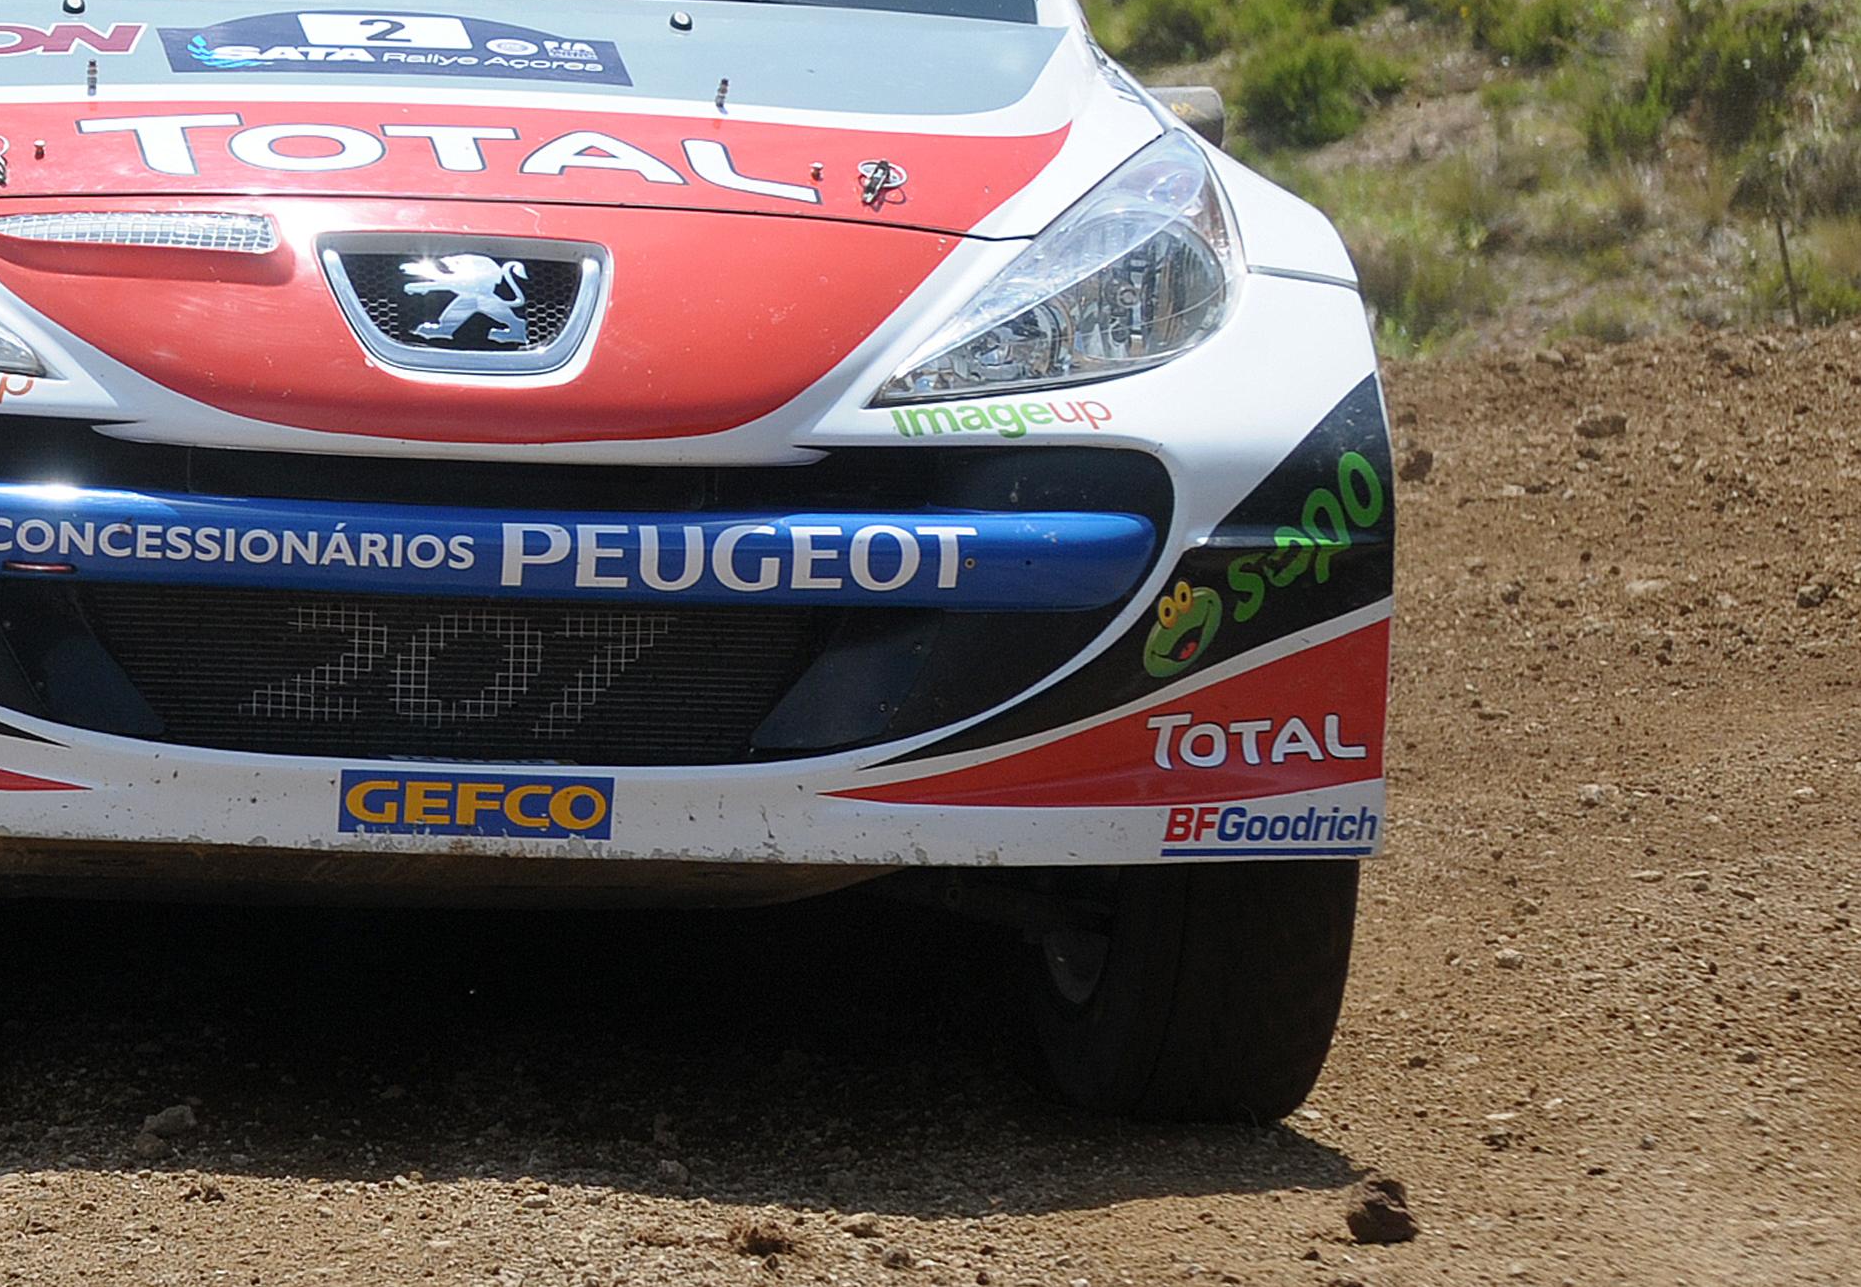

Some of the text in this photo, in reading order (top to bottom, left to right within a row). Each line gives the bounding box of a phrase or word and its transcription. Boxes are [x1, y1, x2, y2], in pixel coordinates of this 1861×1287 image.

[211, 45, 376, 61] SATA
[383, 52, 479, 66] Rallye
[359, 18, 412, 42] 2
[74, 112, 822, 205] TOTAL
[890, 399, 1112, 439] imageup
[500, 522, 977, 593] PEUGEOT
[1228, 451, 1384, 623] sapo
[239, 604, 676, 736] 207
[1146, 713, 1366, 770] TOTAL
[344, 779, 607, 831] GEFCO
[1164, 806, 1377, 843] BFGoodrich
